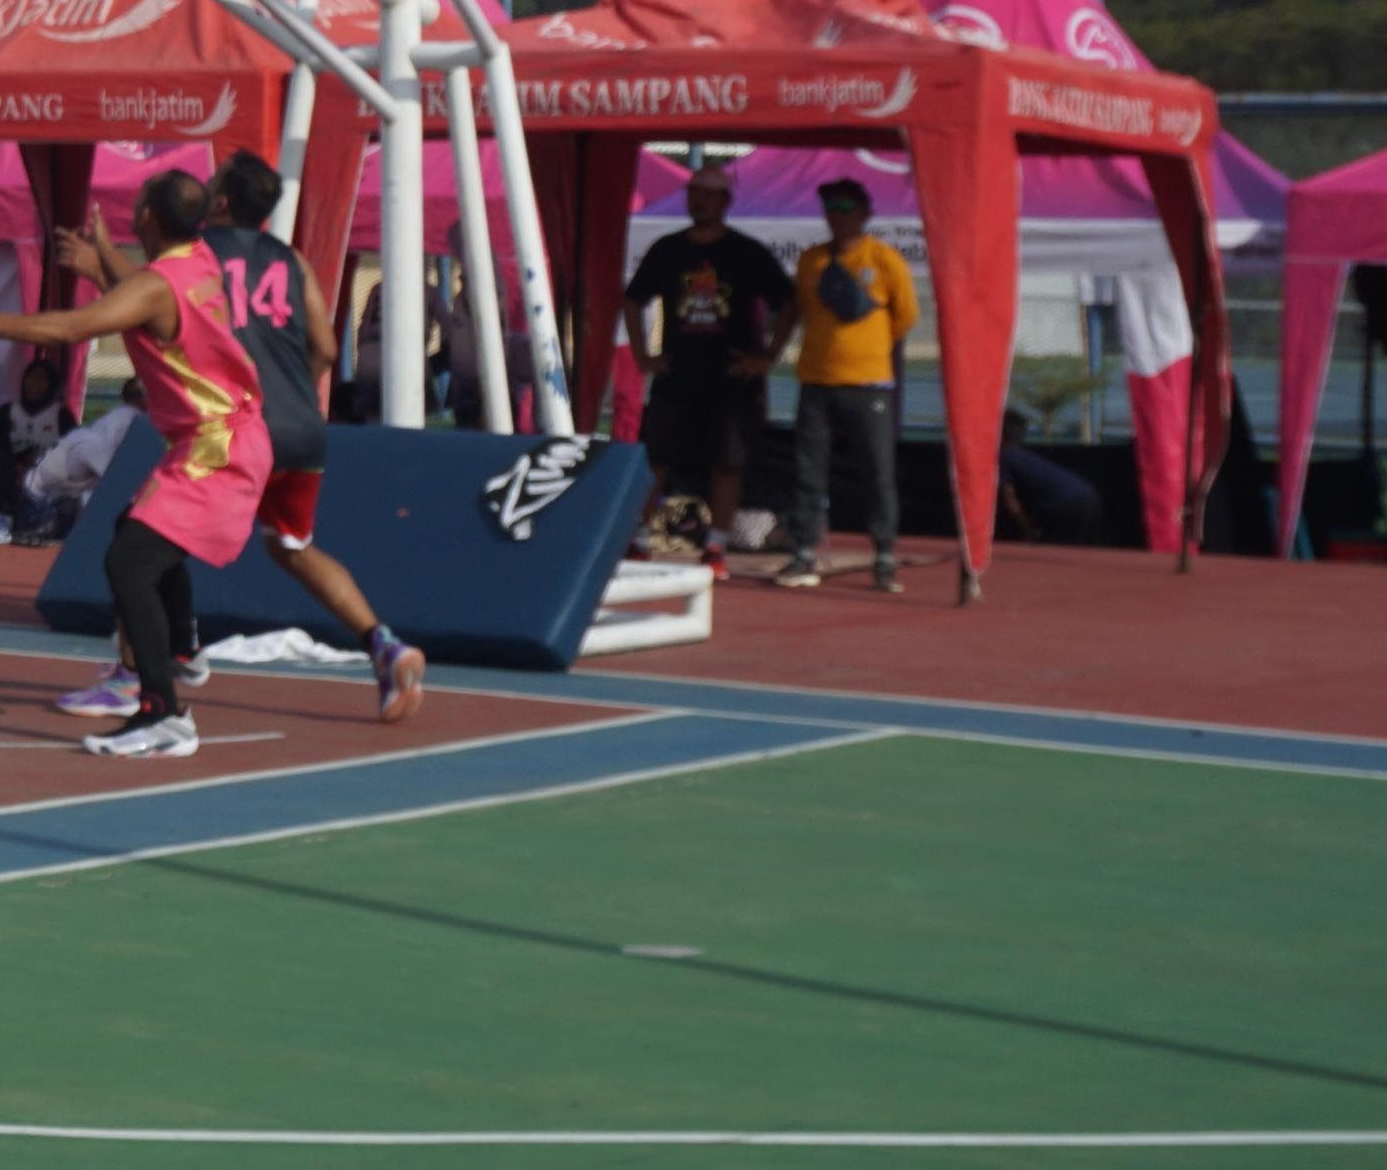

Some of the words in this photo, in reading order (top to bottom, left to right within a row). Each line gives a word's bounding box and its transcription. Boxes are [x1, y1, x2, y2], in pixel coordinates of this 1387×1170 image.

[99, 88, 205, 128] bankjatim
[568, 75, 749, 118] SAMPANG
[778, 72, 884, 113] bankjatim
[224, 257, 294, 329] 14
